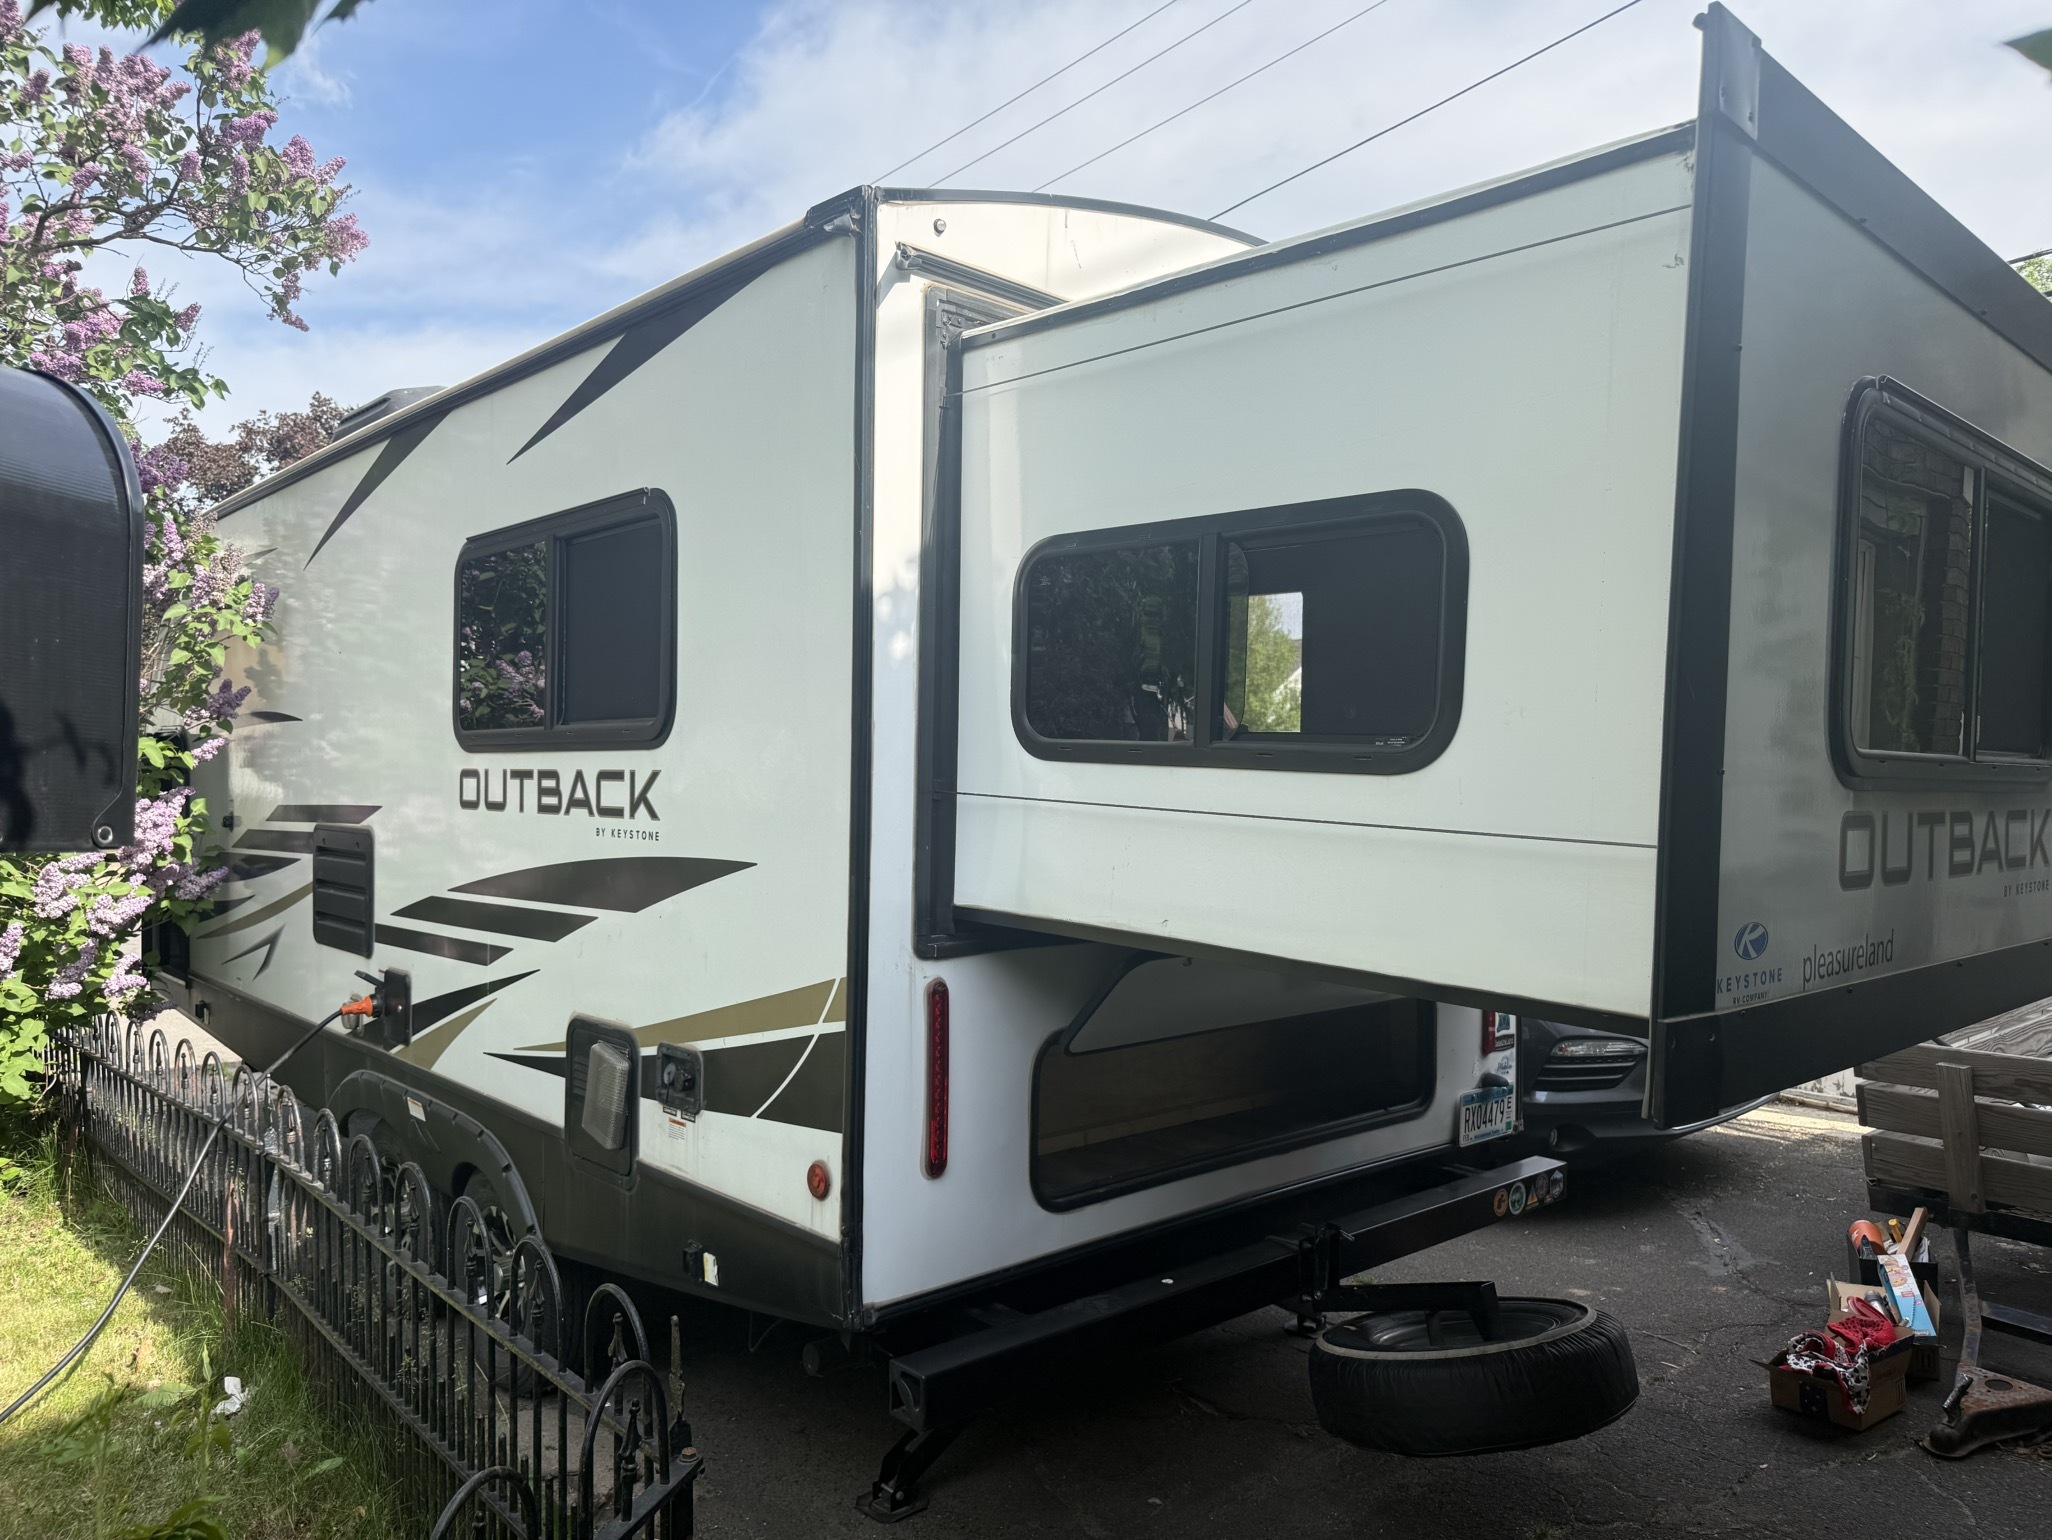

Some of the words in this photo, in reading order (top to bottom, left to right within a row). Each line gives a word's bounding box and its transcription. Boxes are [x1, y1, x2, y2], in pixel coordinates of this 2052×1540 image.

[459, 768, 662, 821] OUTBACK
[595, 827, 607, 838] BY
[610, 828, 660, 842] KEYSTONE
[1839, 808, 2052, 891] OUTBACK
[2003, 885, 2013, 898] BY
[2015, 880, 2049, 896] KEYSTONE
[1802, 928, 1894, 991] pleasureland
[1716, 967, 1783, 994] KEYSTONE
[1464, 1098, 1505, 1134] RX04479
